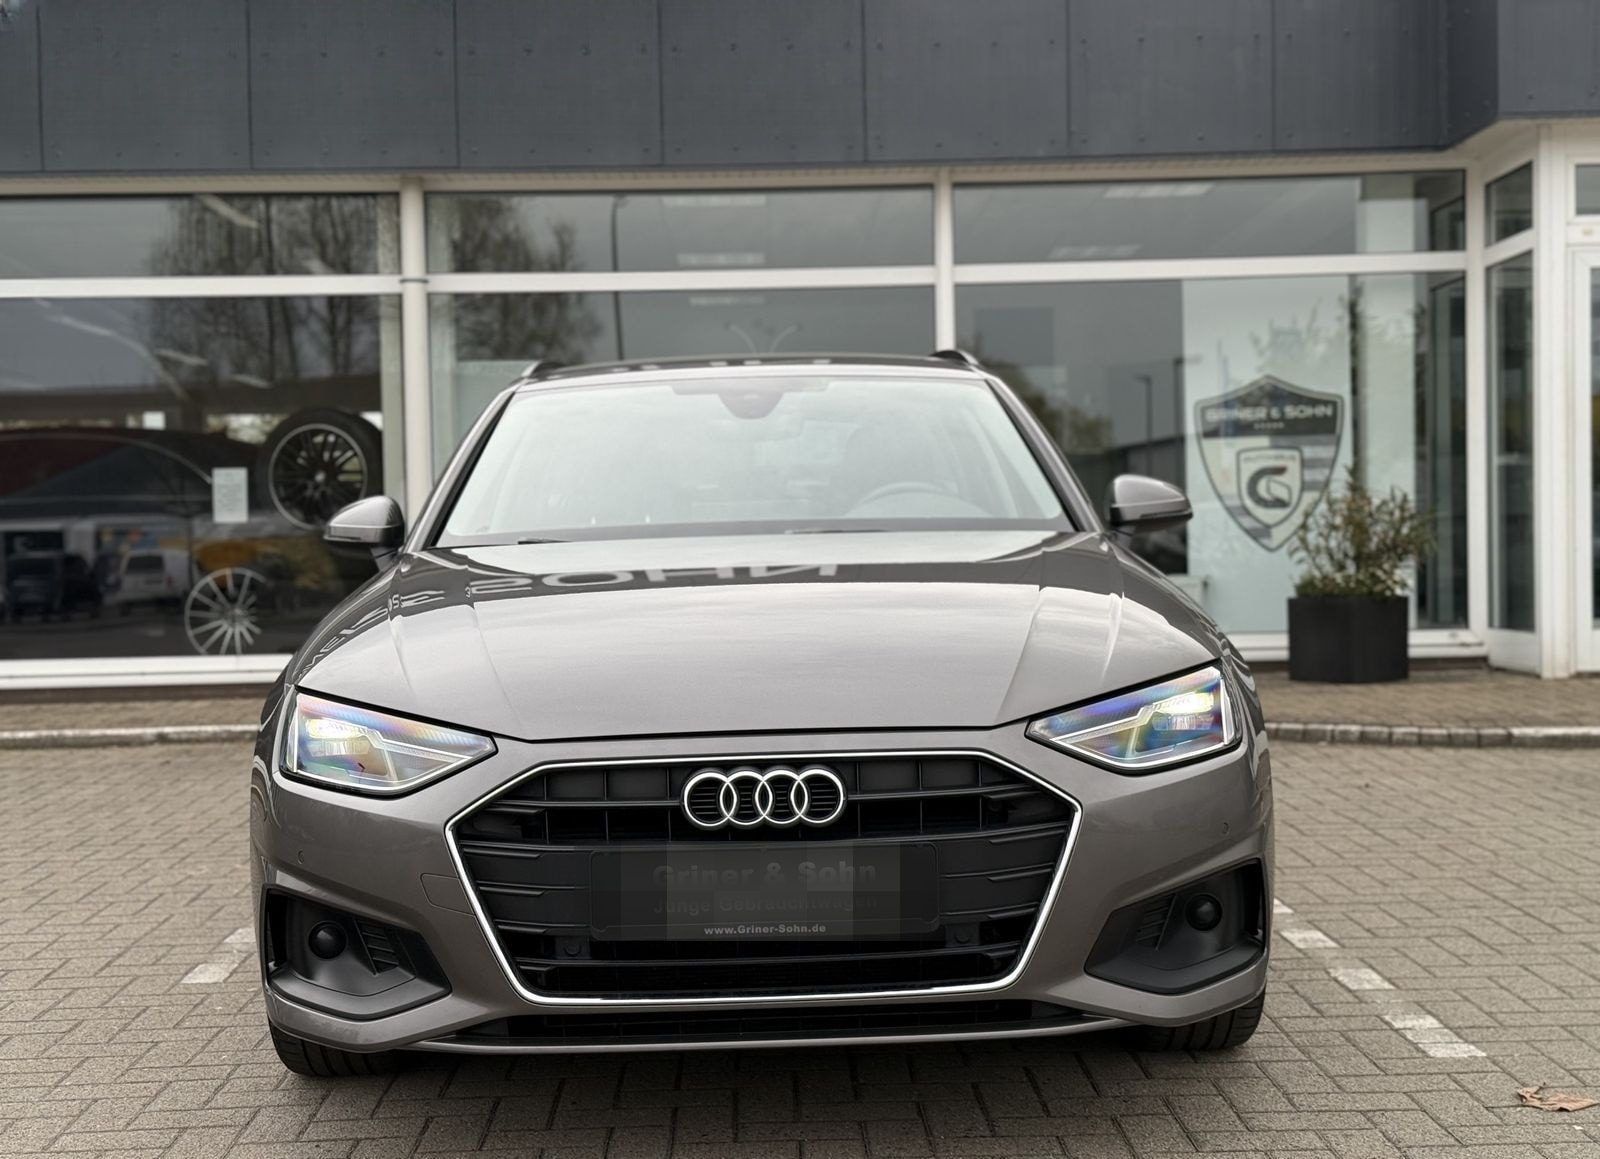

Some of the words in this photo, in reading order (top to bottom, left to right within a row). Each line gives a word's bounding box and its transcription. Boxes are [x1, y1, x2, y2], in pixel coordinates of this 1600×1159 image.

[1284, 403, 1334, 420] SOHN
[652, 864, 754, 887] Griner
[763, 861, 787, 885] &
[797, 860, 877, 884] Sohn
[653, 895, 711, 916] Junge
[719, 893, 878, 914] Gebrauchtwagen
[703, 923, 827, 935] www.Griner-Sohn.de
